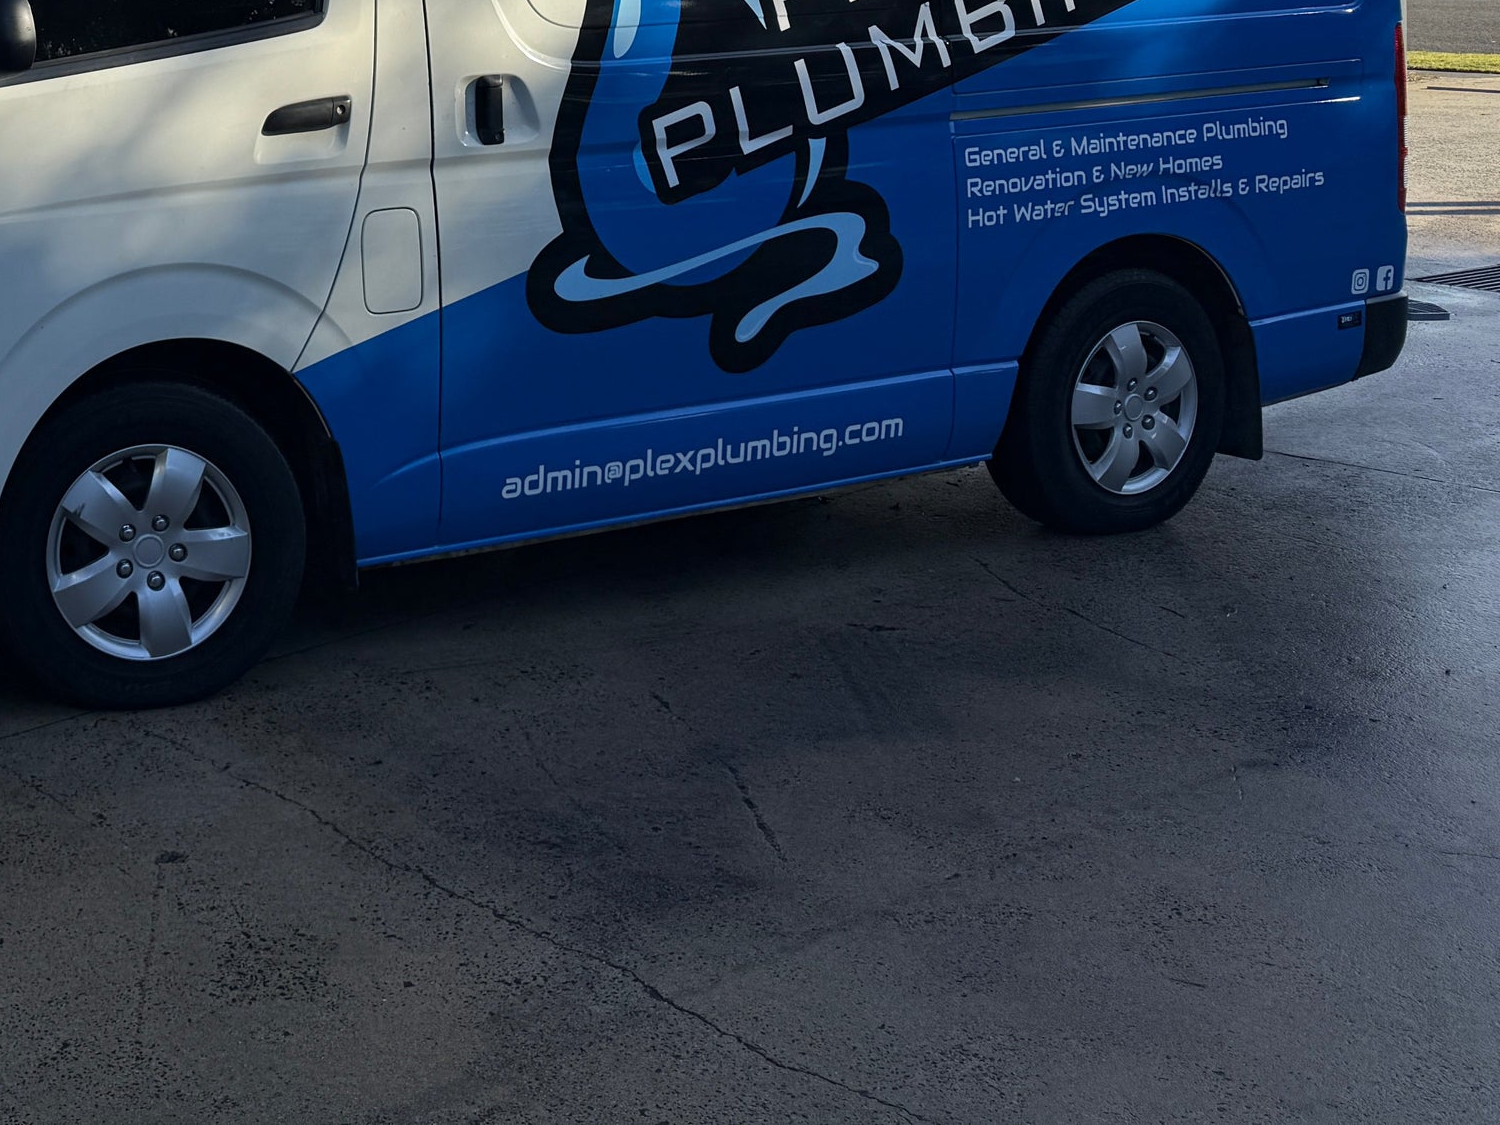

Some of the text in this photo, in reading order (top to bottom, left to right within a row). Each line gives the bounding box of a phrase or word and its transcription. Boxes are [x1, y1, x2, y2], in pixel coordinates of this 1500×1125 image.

[964, 116, 1289, 168] General & Maintenance Plumbing
[967, 154, 1223, 198] Renovation & New Homes
[967, 168, 1325, 228] Hot Water System Installs & Repairs
[501, 416, 904, 500] admin@plexplumbing.com
